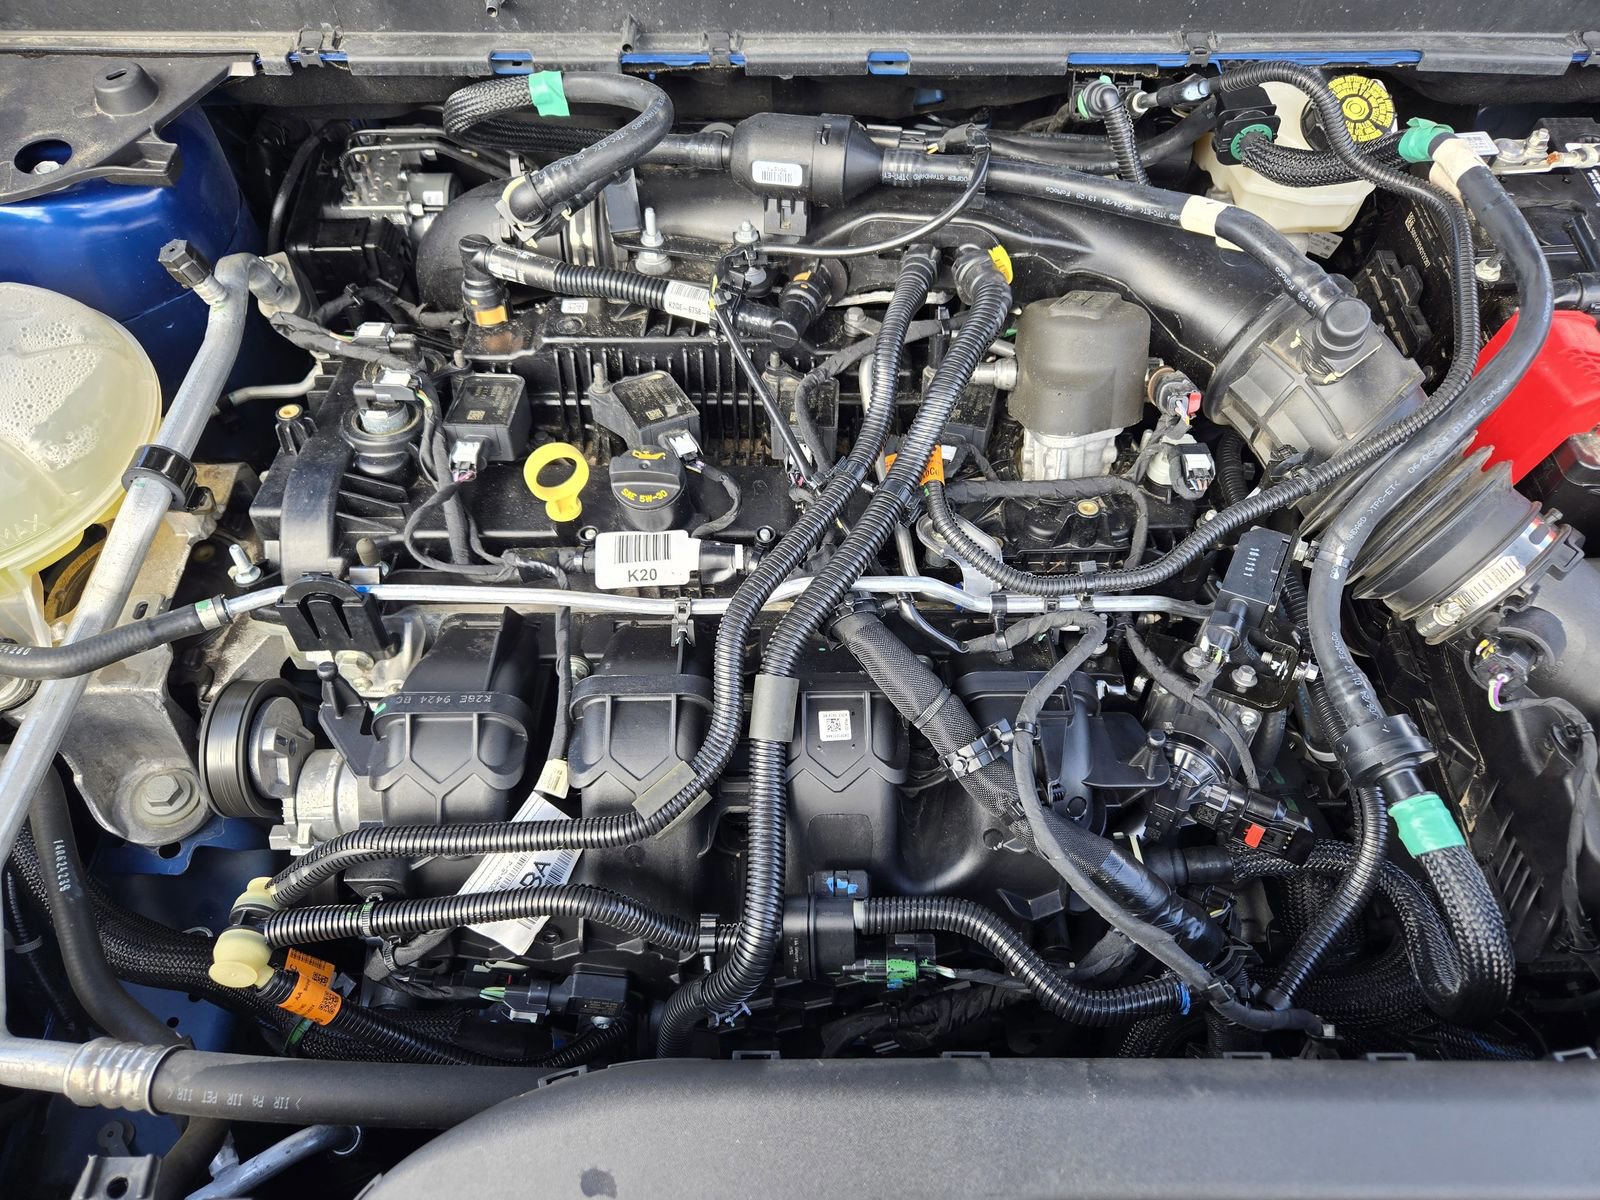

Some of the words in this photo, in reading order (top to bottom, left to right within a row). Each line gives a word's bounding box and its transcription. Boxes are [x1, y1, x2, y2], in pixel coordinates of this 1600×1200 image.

[620, 488, 638, 502] SAE
[639, 490, 668, 503] 5W-30
[627, 568, 658, 582] K20
[420, 695, 451, 703] 9424
[201, 1090, 218, 1104] PET
